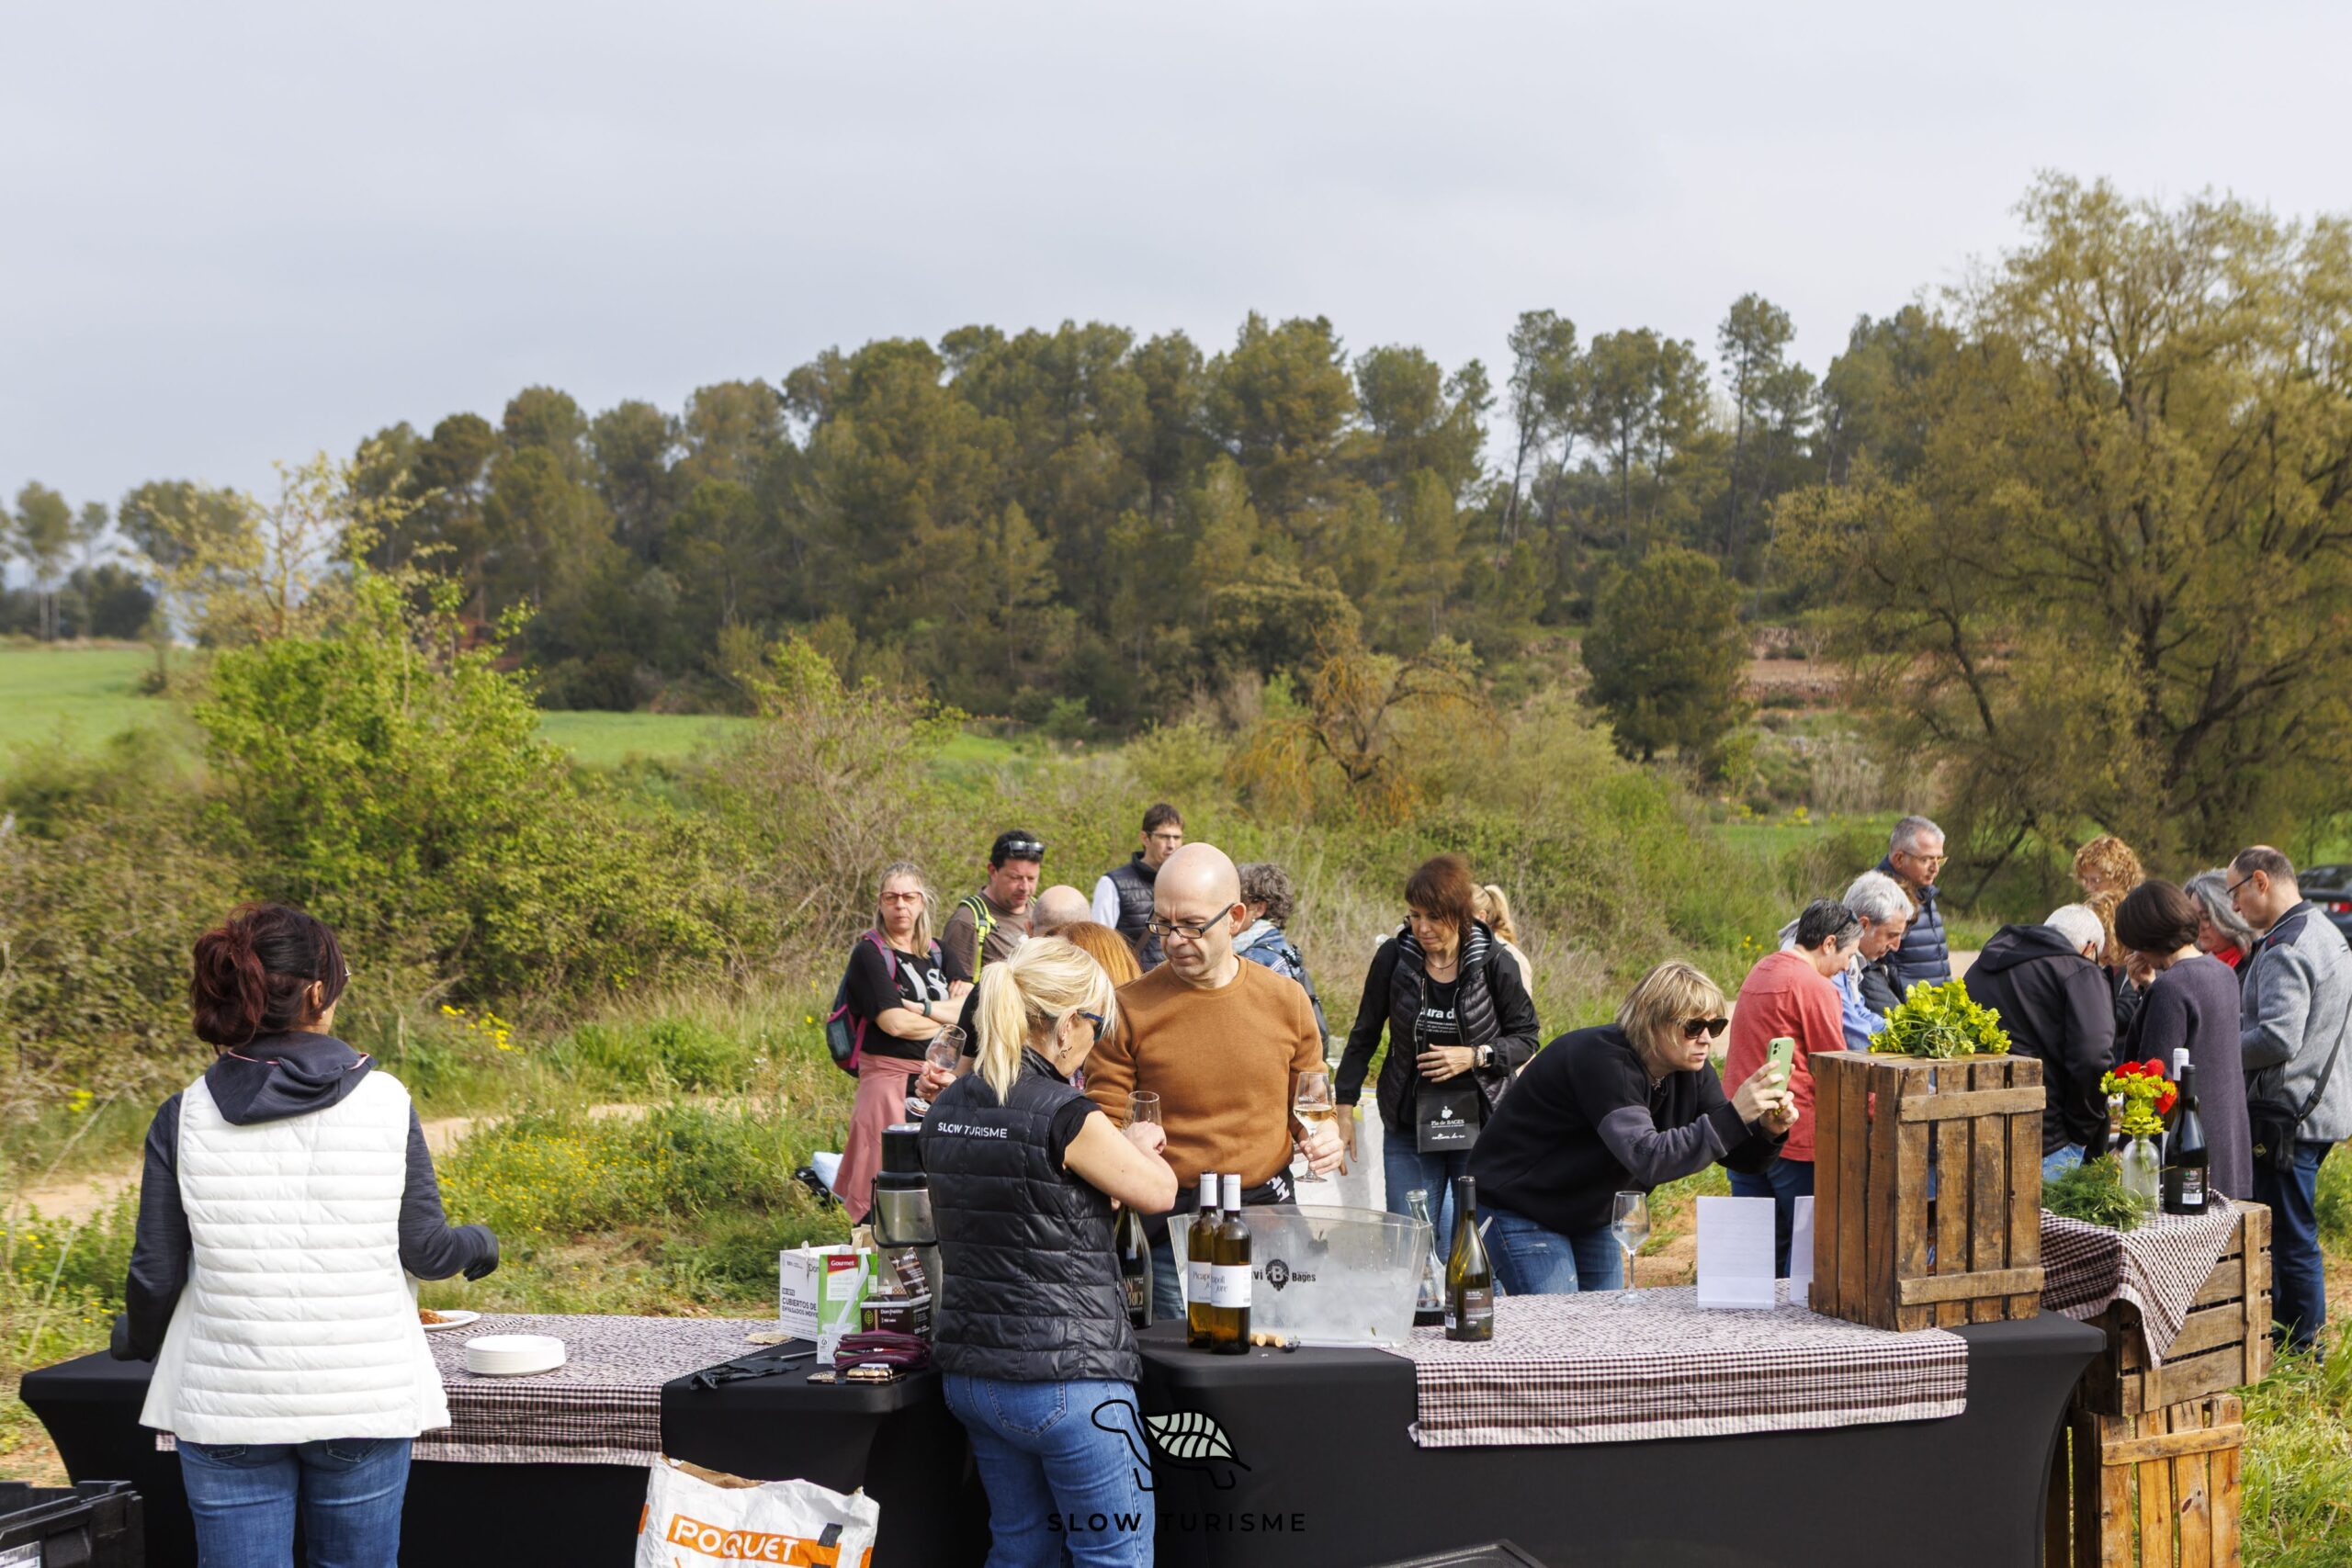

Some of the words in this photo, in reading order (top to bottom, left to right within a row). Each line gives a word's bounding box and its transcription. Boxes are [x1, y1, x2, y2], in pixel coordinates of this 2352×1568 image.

[1422, 1008, 1444, 1020] ura
[1446, 1008, 1455, 1020] d
[937, 1122, 963, 1134] SLOW
[964, 1124, 1008, 1139] TURISME
[808, 1262, 820, 1274] Don
[830, 1259, 855, 1268] Gourmet
[1251, 1269, 1263, 1280] vi
[1292, 1272, 1317, 1283] Bages
[782, 1297, 809, 1310] CUBIERTOS
[809, 1302, 817, 1311] DE
[673, 1518, 800, 1562] POQUET
